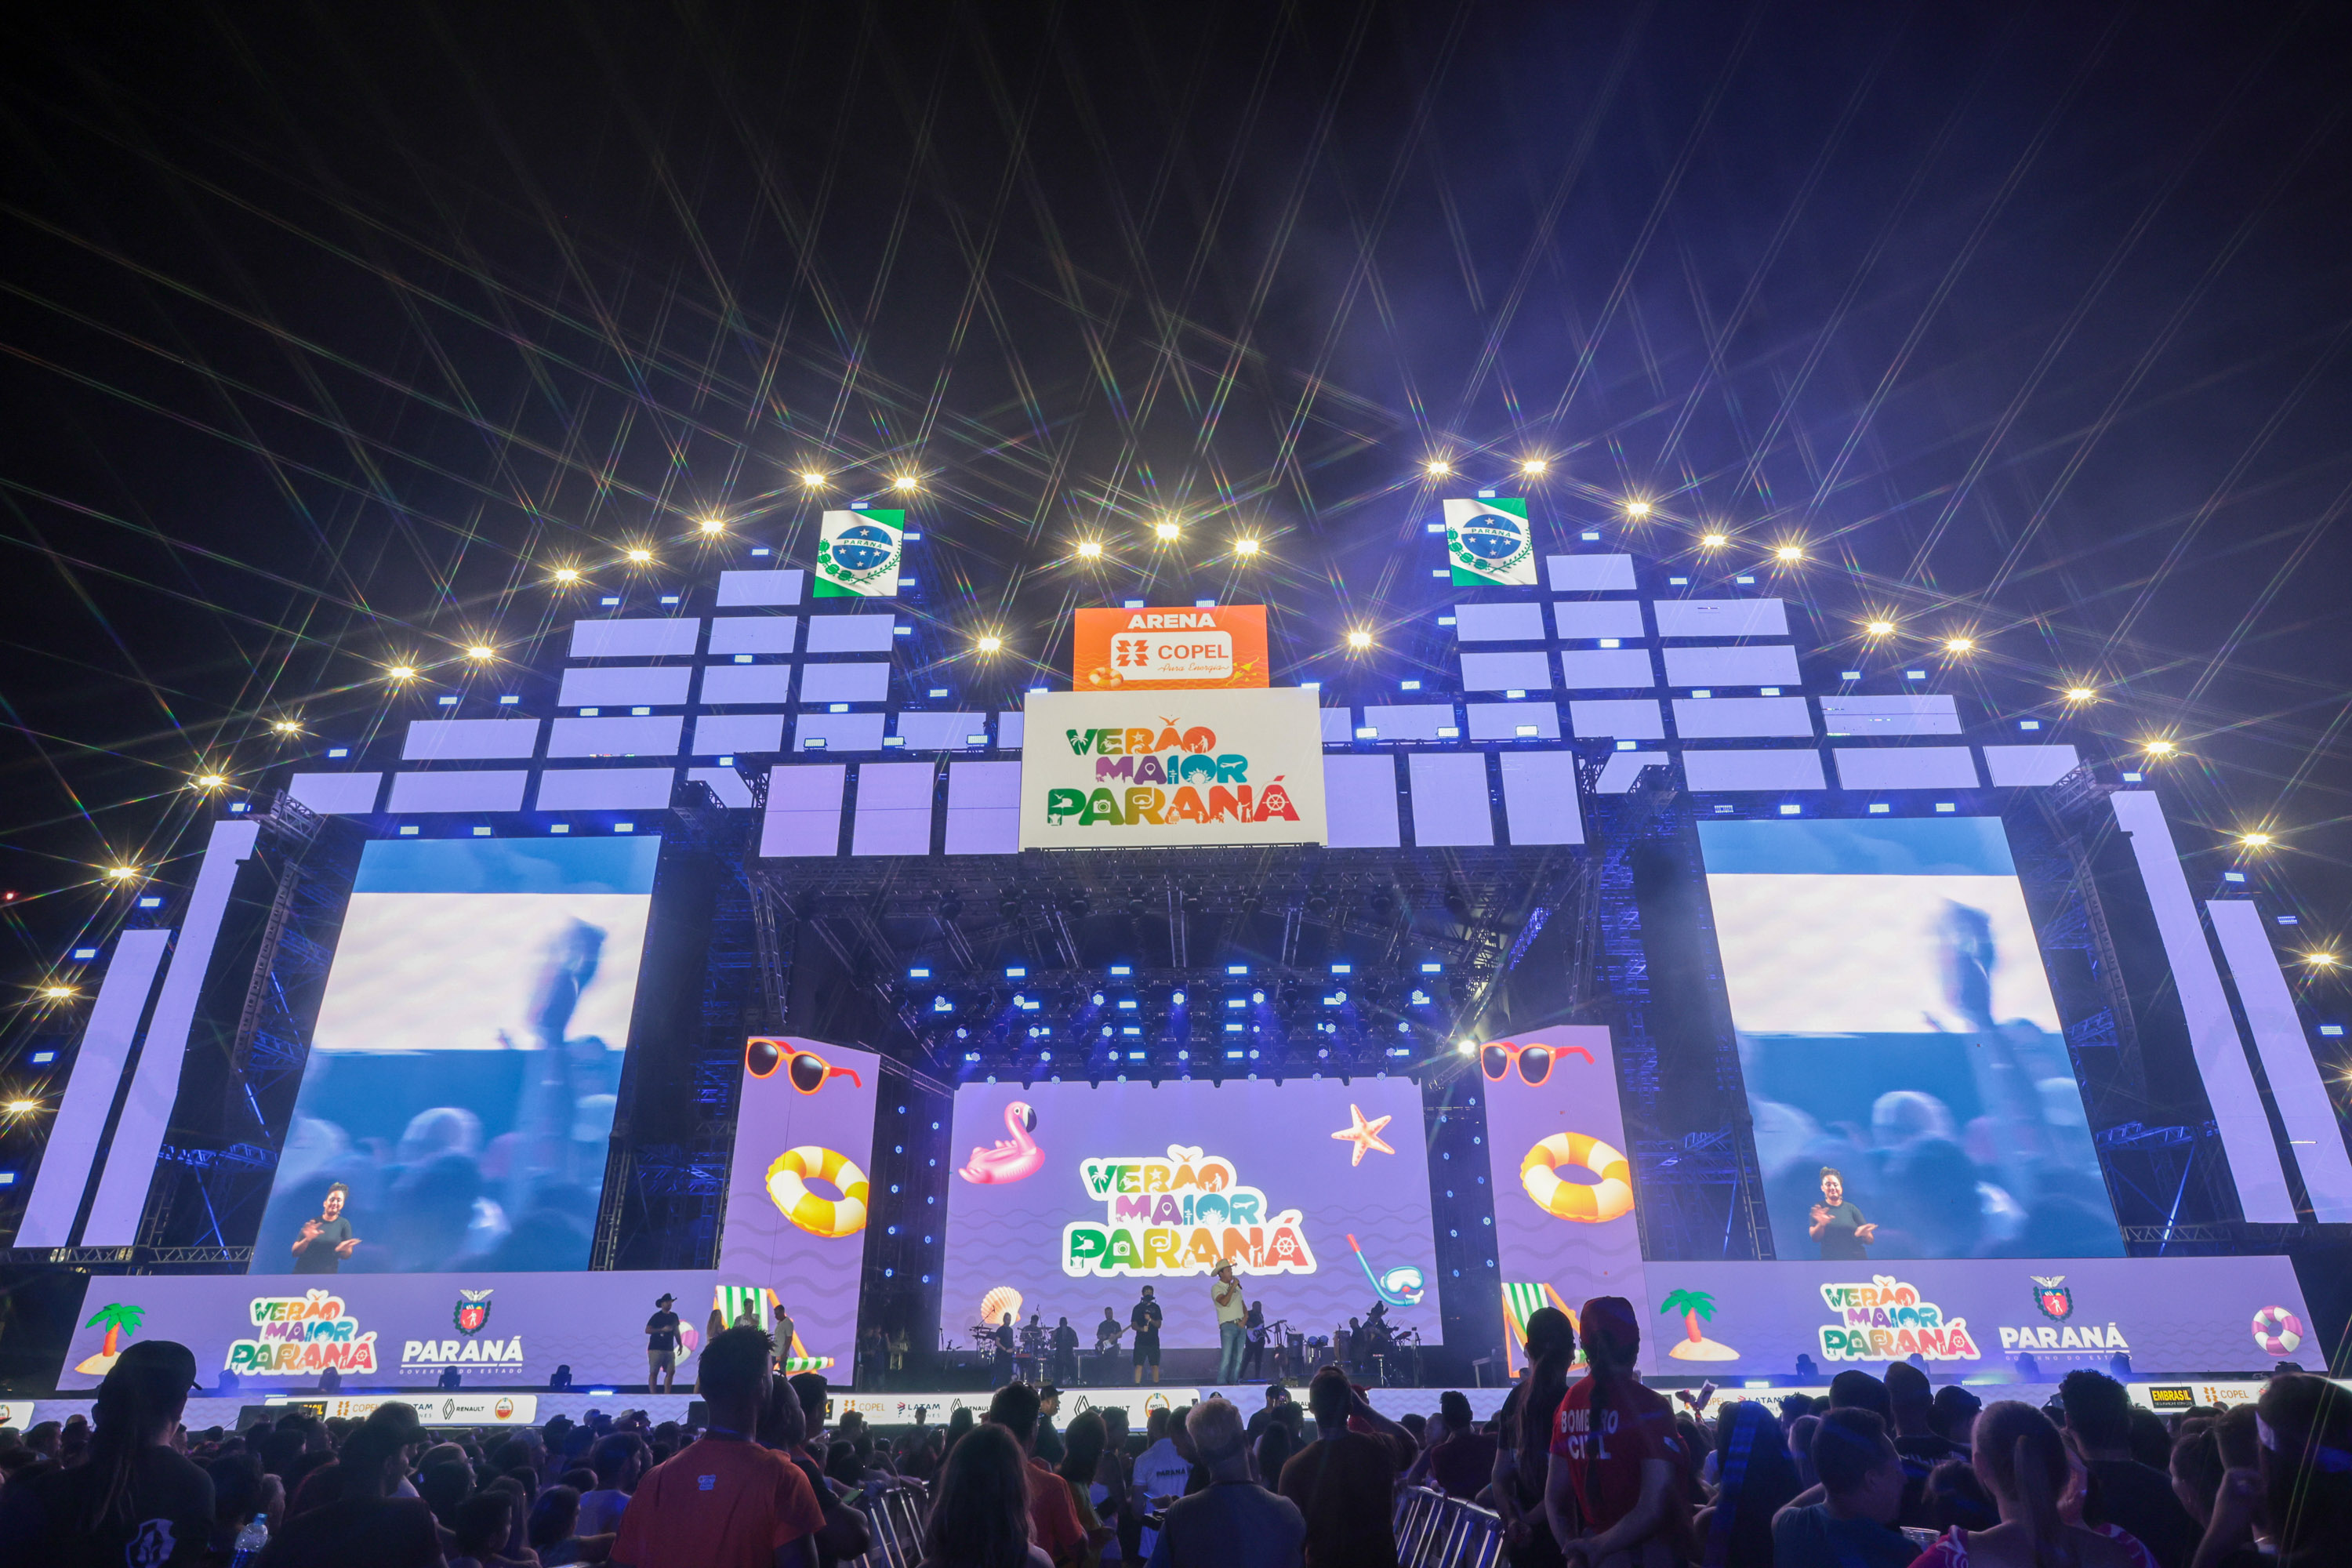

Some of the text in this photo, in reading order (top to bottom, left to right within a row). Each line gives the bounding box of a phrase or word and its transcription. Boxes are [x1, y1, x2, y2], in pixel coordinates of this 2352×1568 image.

[1127, 613, 1217, 629] ARENA
[1158, 644, 1229, 659] COPEL
[1159, 662, 1229, 673] Pura Energia
[1065, 715, 1216, 755] VERÃO
[1095, 754, 1248, 785] MAIOR
[1047, 775, 1301, 826] PARANÁ
[1087, 1152, 1229, 1193] VERÃO
[1116, 1193, 1260, 1225] MAIOR
[1070, 1217, 1308, 1269] PARANÁ
[1825, 1280, 1915, 1307] VERÃO
[255, 1294, 340, 1321] VERÃO
[1847, 1307, 1939, 1328] MAIOR
[264, 1321, 354, 1342] MAIOR
[1824, 1323, 1976, 1356] PARANÁ
[1998, 1322, 2129, 1348] PARANÁ
[230, 1336, 373, 1370] PARANÁ
[401, 1335, 524, 1362] PARANÁ
[859, 1403, 885, 1411] COPEL
[2152, 1390, 2192, 1401] EMBRASIL
[2220, 1390, 2249, 1399] COPEL
[1568, 1435, 1612, 1460] CIL
